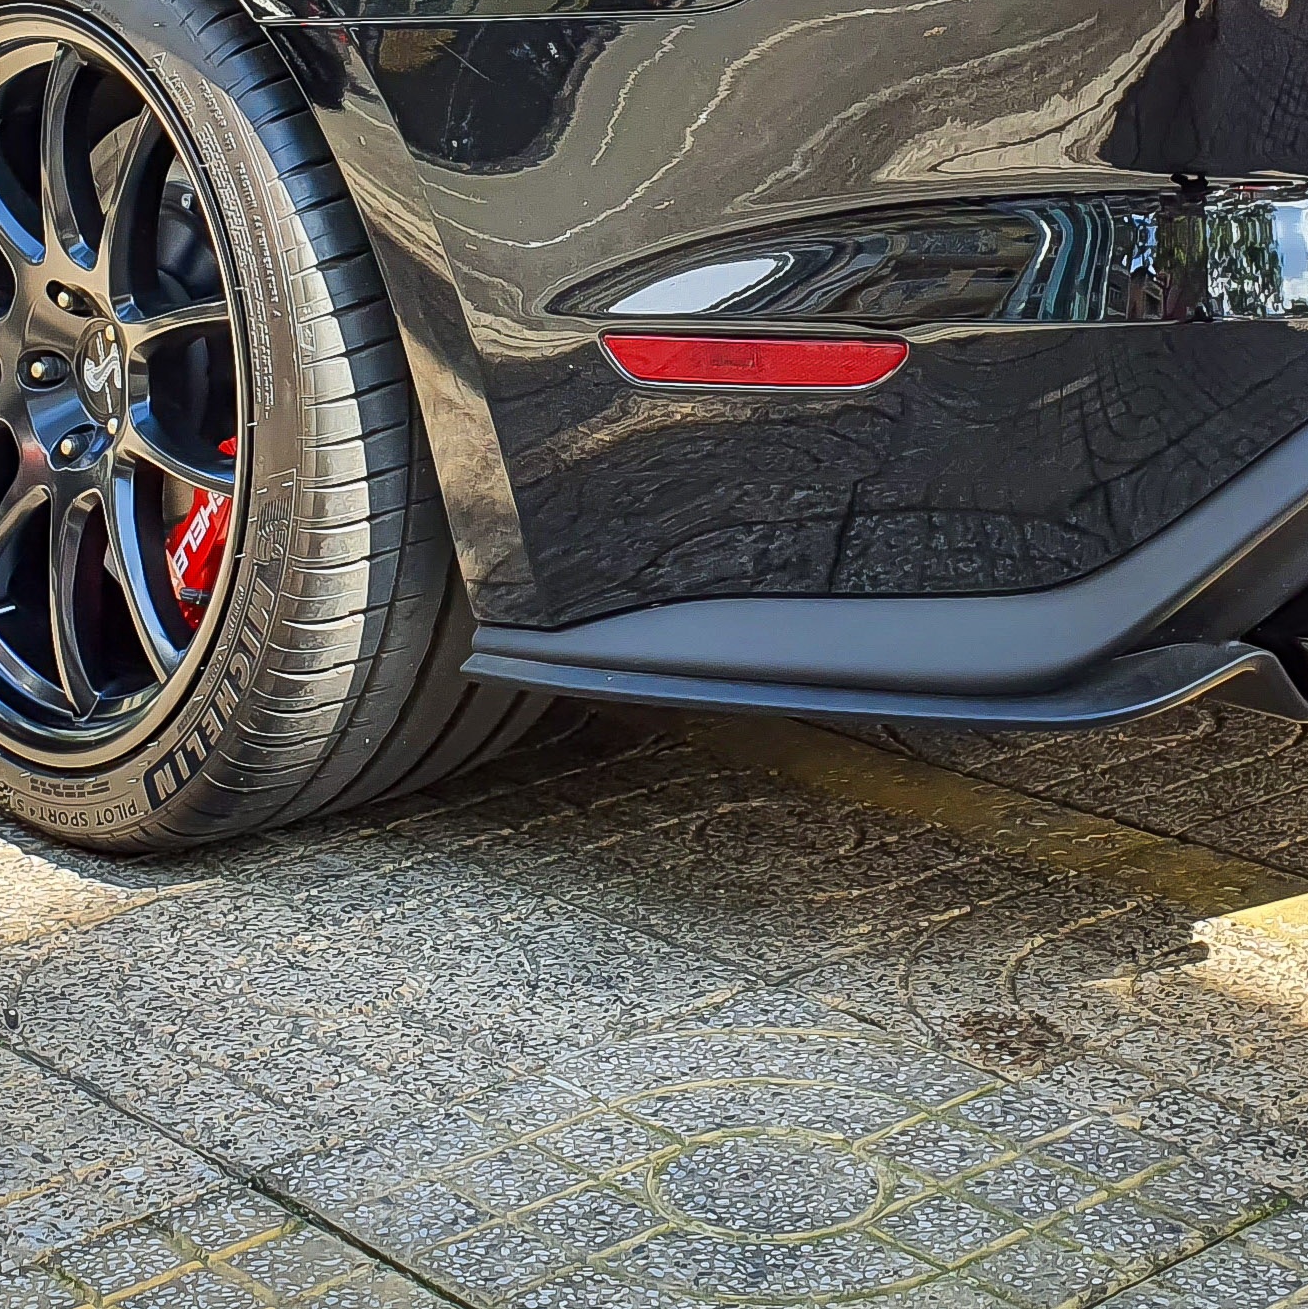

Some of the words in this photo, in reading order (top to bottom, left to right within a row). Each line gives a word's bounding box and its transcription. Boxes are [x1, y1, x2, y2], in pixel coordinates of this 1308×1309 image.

[152, 576, 275, 802] MICHELIN
[38, 806, 89, 827] SPORT
[96, 798, 138, 826] PILOT
